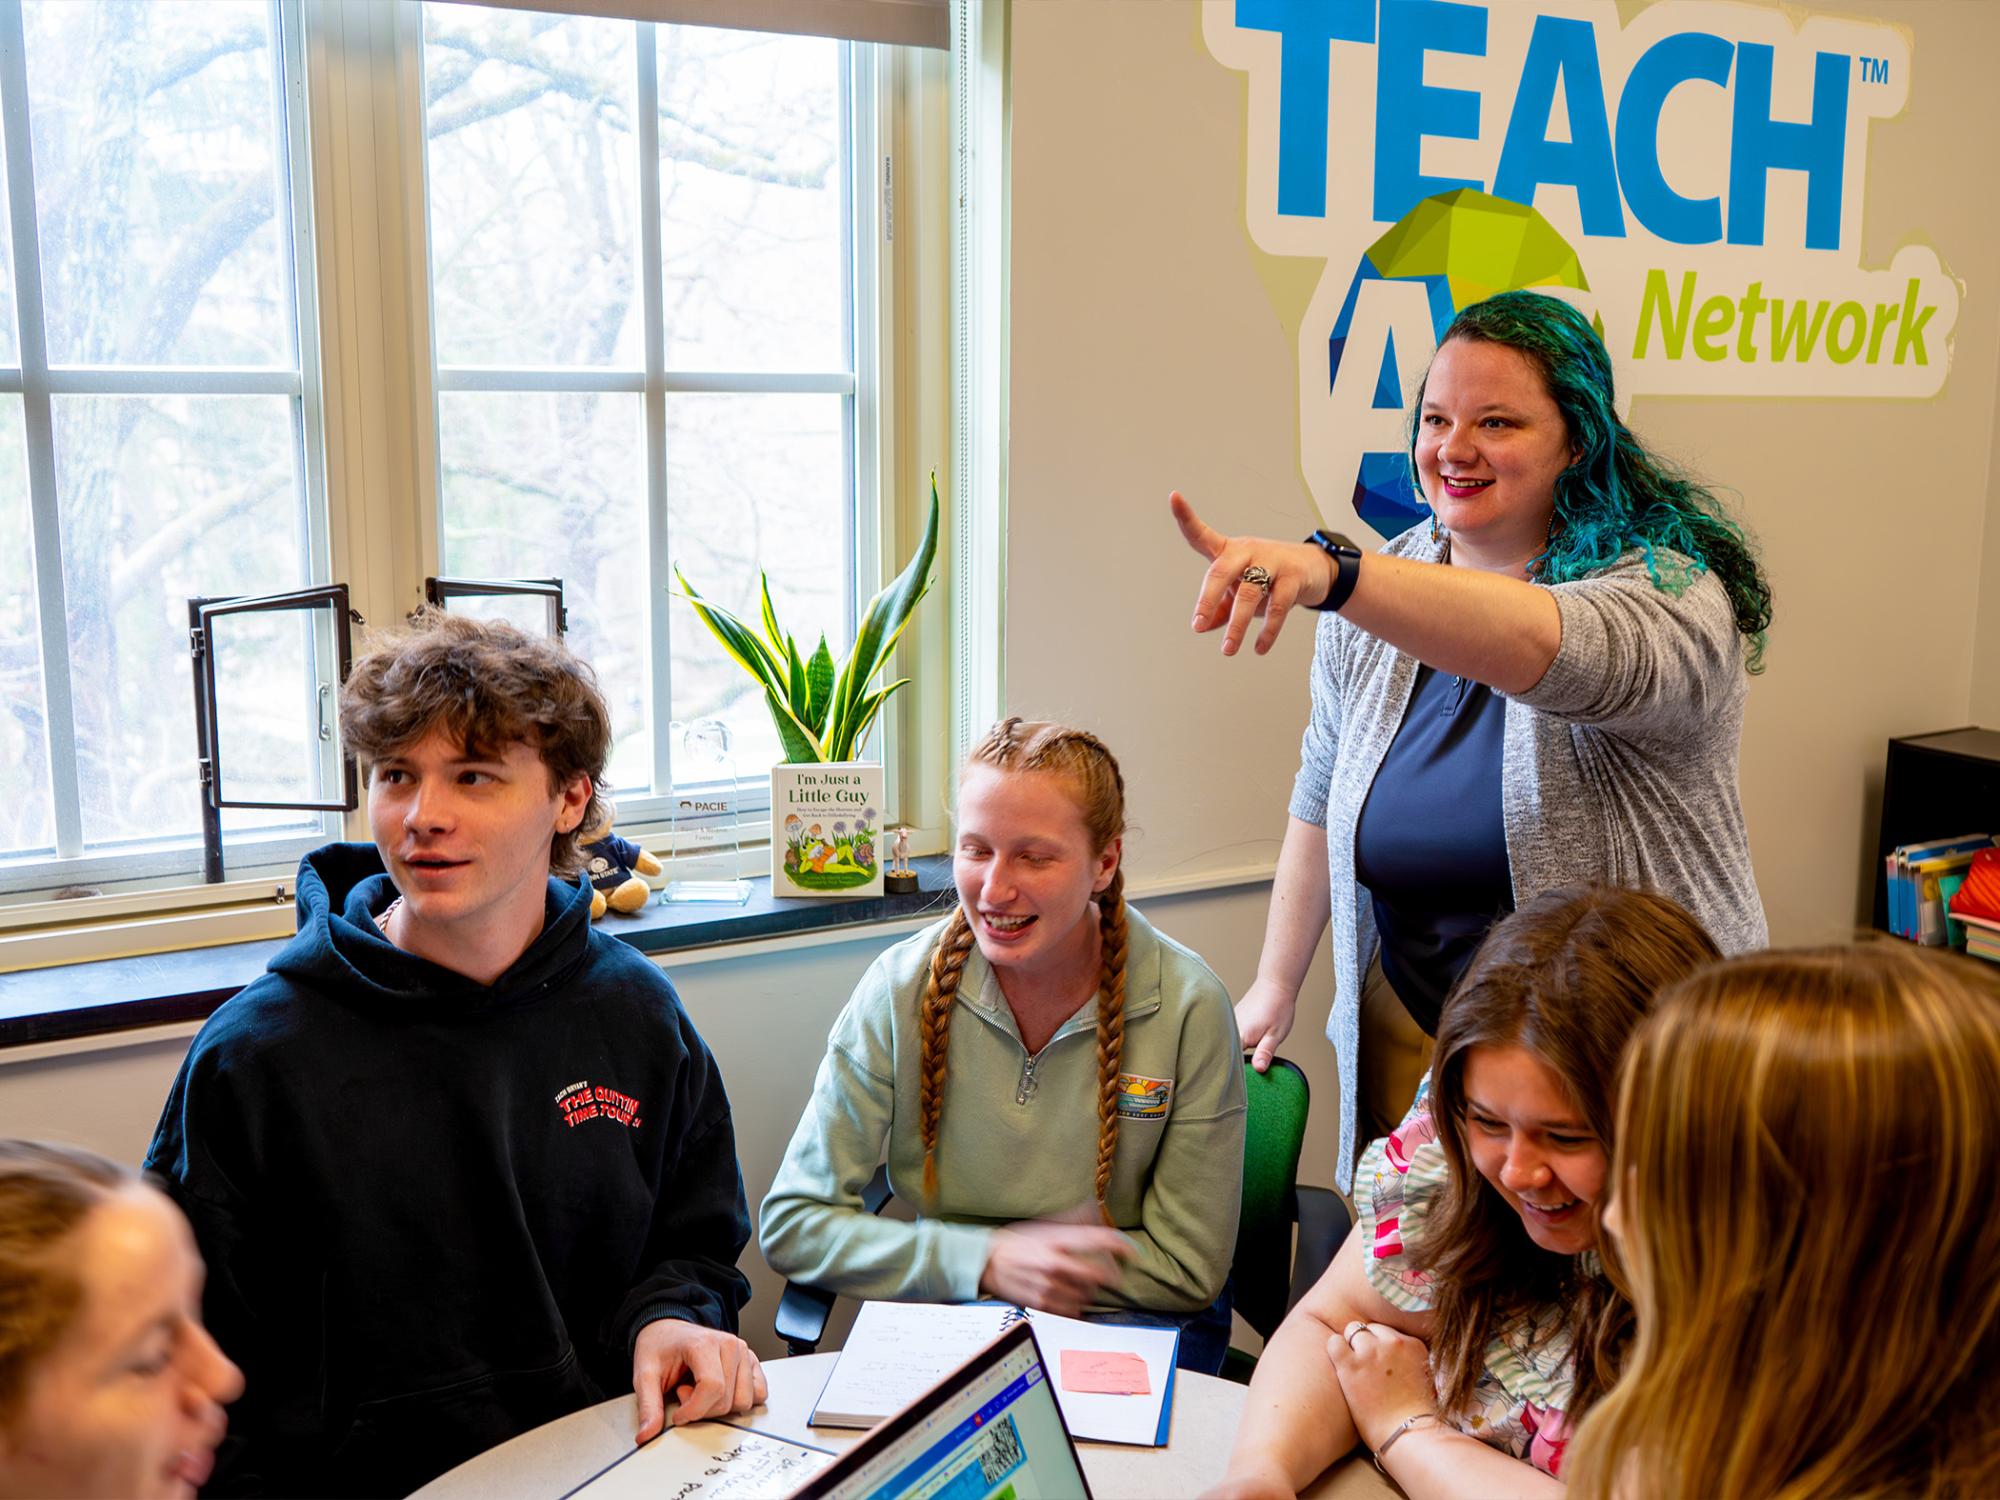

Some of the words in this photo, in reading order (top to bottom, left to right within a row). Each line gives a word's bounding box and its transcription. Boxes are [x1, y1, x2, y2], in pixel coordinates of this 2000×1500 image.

[1236, 0, 1851, 250] TEACH
[1632, 268, 1937, 367] Network
[797, 773, 817, 785] I'm
[820, 773, 849, 786] Just
[853, 775, 861, 785] a
[695, 802, 727, 812] PACIE
[788, 788, 831, 803] Little
[835, 788, 870, 806] Guy
[560, 1087, 594, 1113] THE
[595, 1086, 640, 1115] QUITTIN
[564, 1104, 598, 1127] TIME
[600, 1103, 633, 1126] TOUR
